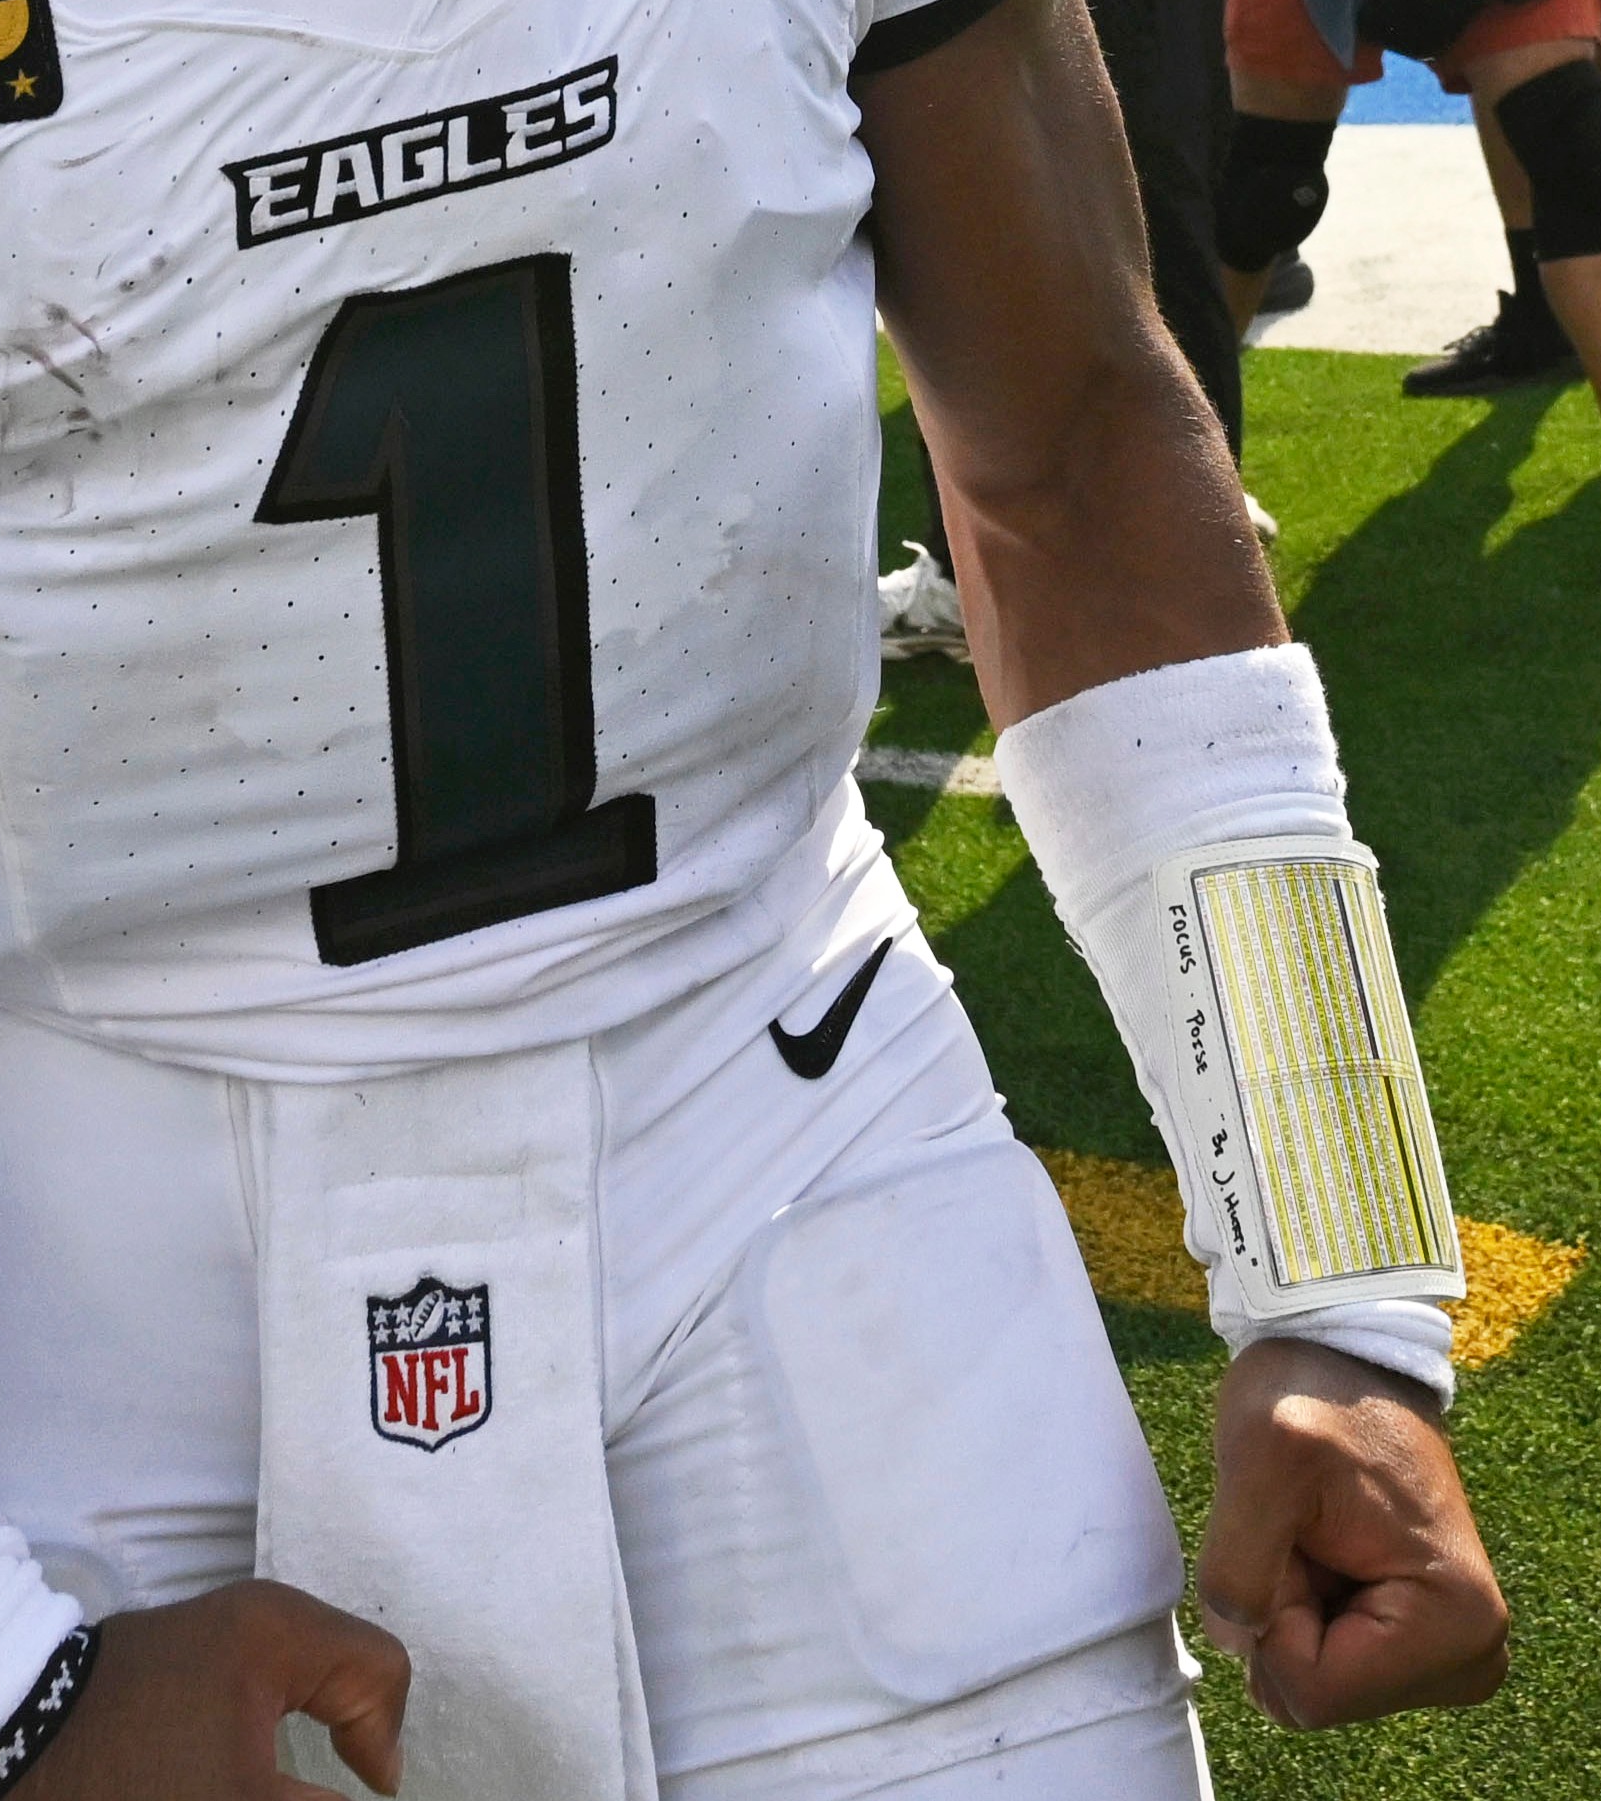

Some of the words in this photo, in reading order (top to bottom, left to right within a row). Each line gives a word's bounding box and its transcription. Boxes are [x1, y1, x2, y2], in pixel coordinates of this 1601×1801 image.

[242, 68, 614, 237] EAGLES
[254, 252, 659, 967] 1
[1168, 904, 1197, 975] FOCUS
[1186, 1009, 1209, 1075] POISE
[380, 1346, 481, 1431] NFL
